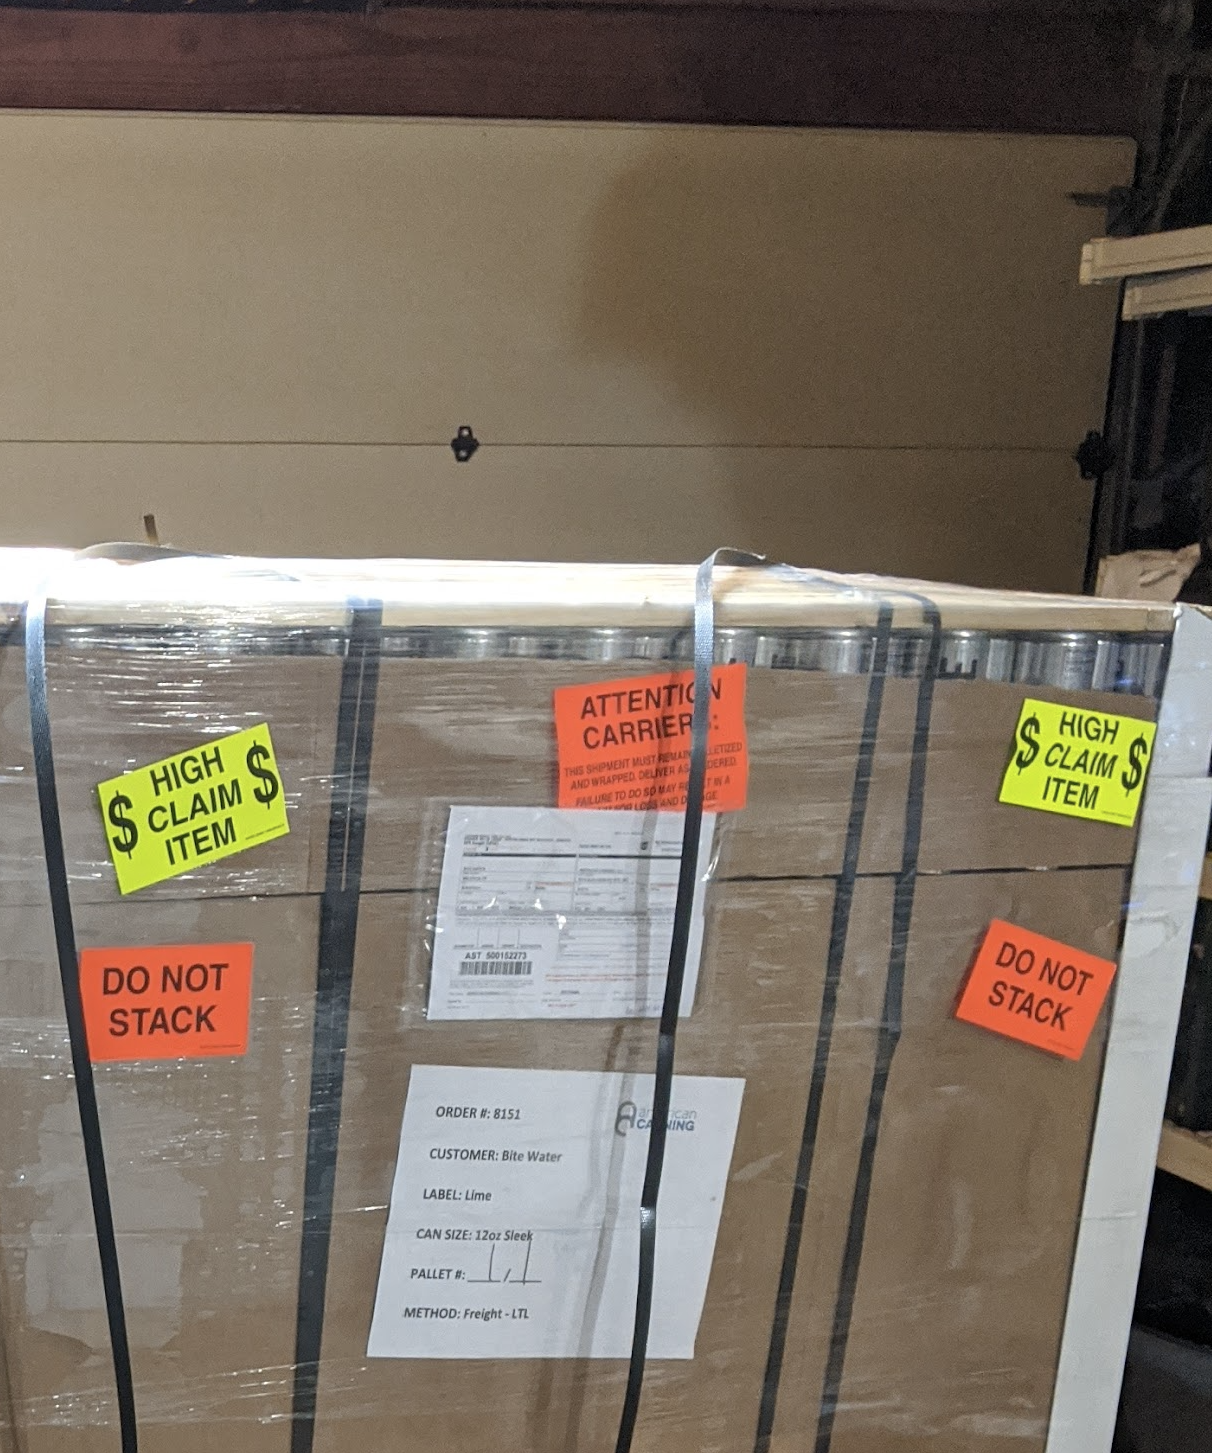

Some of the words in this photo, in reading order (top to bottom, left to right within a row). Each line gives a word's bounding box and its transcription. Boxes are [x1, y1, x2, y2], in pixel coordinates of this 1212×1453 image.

[583, 713, 720, 750] CARRIER:
[1059, 711, 1120, 745] HIGH
[150, 746, 225, 796] HIGH
[564, 765, 584, 778] THIS
[586, 758, 630, 775] SHIPMENT
[632, 755, 656, 767] MUST
[1044, 742, 1119, 779] CLAIM
[570, 779, 589, 791] AND
[638, 765, 675, 780] DELIVER
[1042, 776, 1100, 810] ITEM
[147, 779, 243, 833] CLAIM
[576, 792, 613, 807] FAILURE
[615, 790, 626, 800] TO
[629, 788, 642, 798] DO
[644, 786, 656, 797] SO
[658, 783, 677, 794] MAY
[164, 817, 238, 866] ITEM
[465, 952, 482, 960] AST
[995, 942, 1035, 975] DO
[1038, 957, 1094, 996] NOT
[102, 966, 151, 995] DO
[161, 963, 229, 993] NOT
[109, 1005, 217, 1036] STACK
[988, 980, 1074, 1031] STACK
[436, 1106, 477, 1119] ORDER
[480, 1108, 490, 1119] #:
[493, 1108, 521, 1120] 8151
[429, 1148, 498, 1161] CUSTOMER:
[501, 1150, 524, 1162] Bite
[527, 1151, 563, 1162] Water
[423, 1188, 462, 1200] LABEL:
[465, 1189, 492, 1201] Lime
[416, 1228, 442, 1240] CAN
[444, 1229, 472, 1241] SIZE:
[475, 1230, 501, 1241] 12oz
[503, 1230, 533, 1241] Sleek
[410, 1268, 453, 1280] PALLET
[455, 1269, 466, 1280] #:
[403, 1307, 461, 1319] METHOD:
[463, 1308, 502, 1321] Freight
[511, 1308, 529, 1319] LTL
